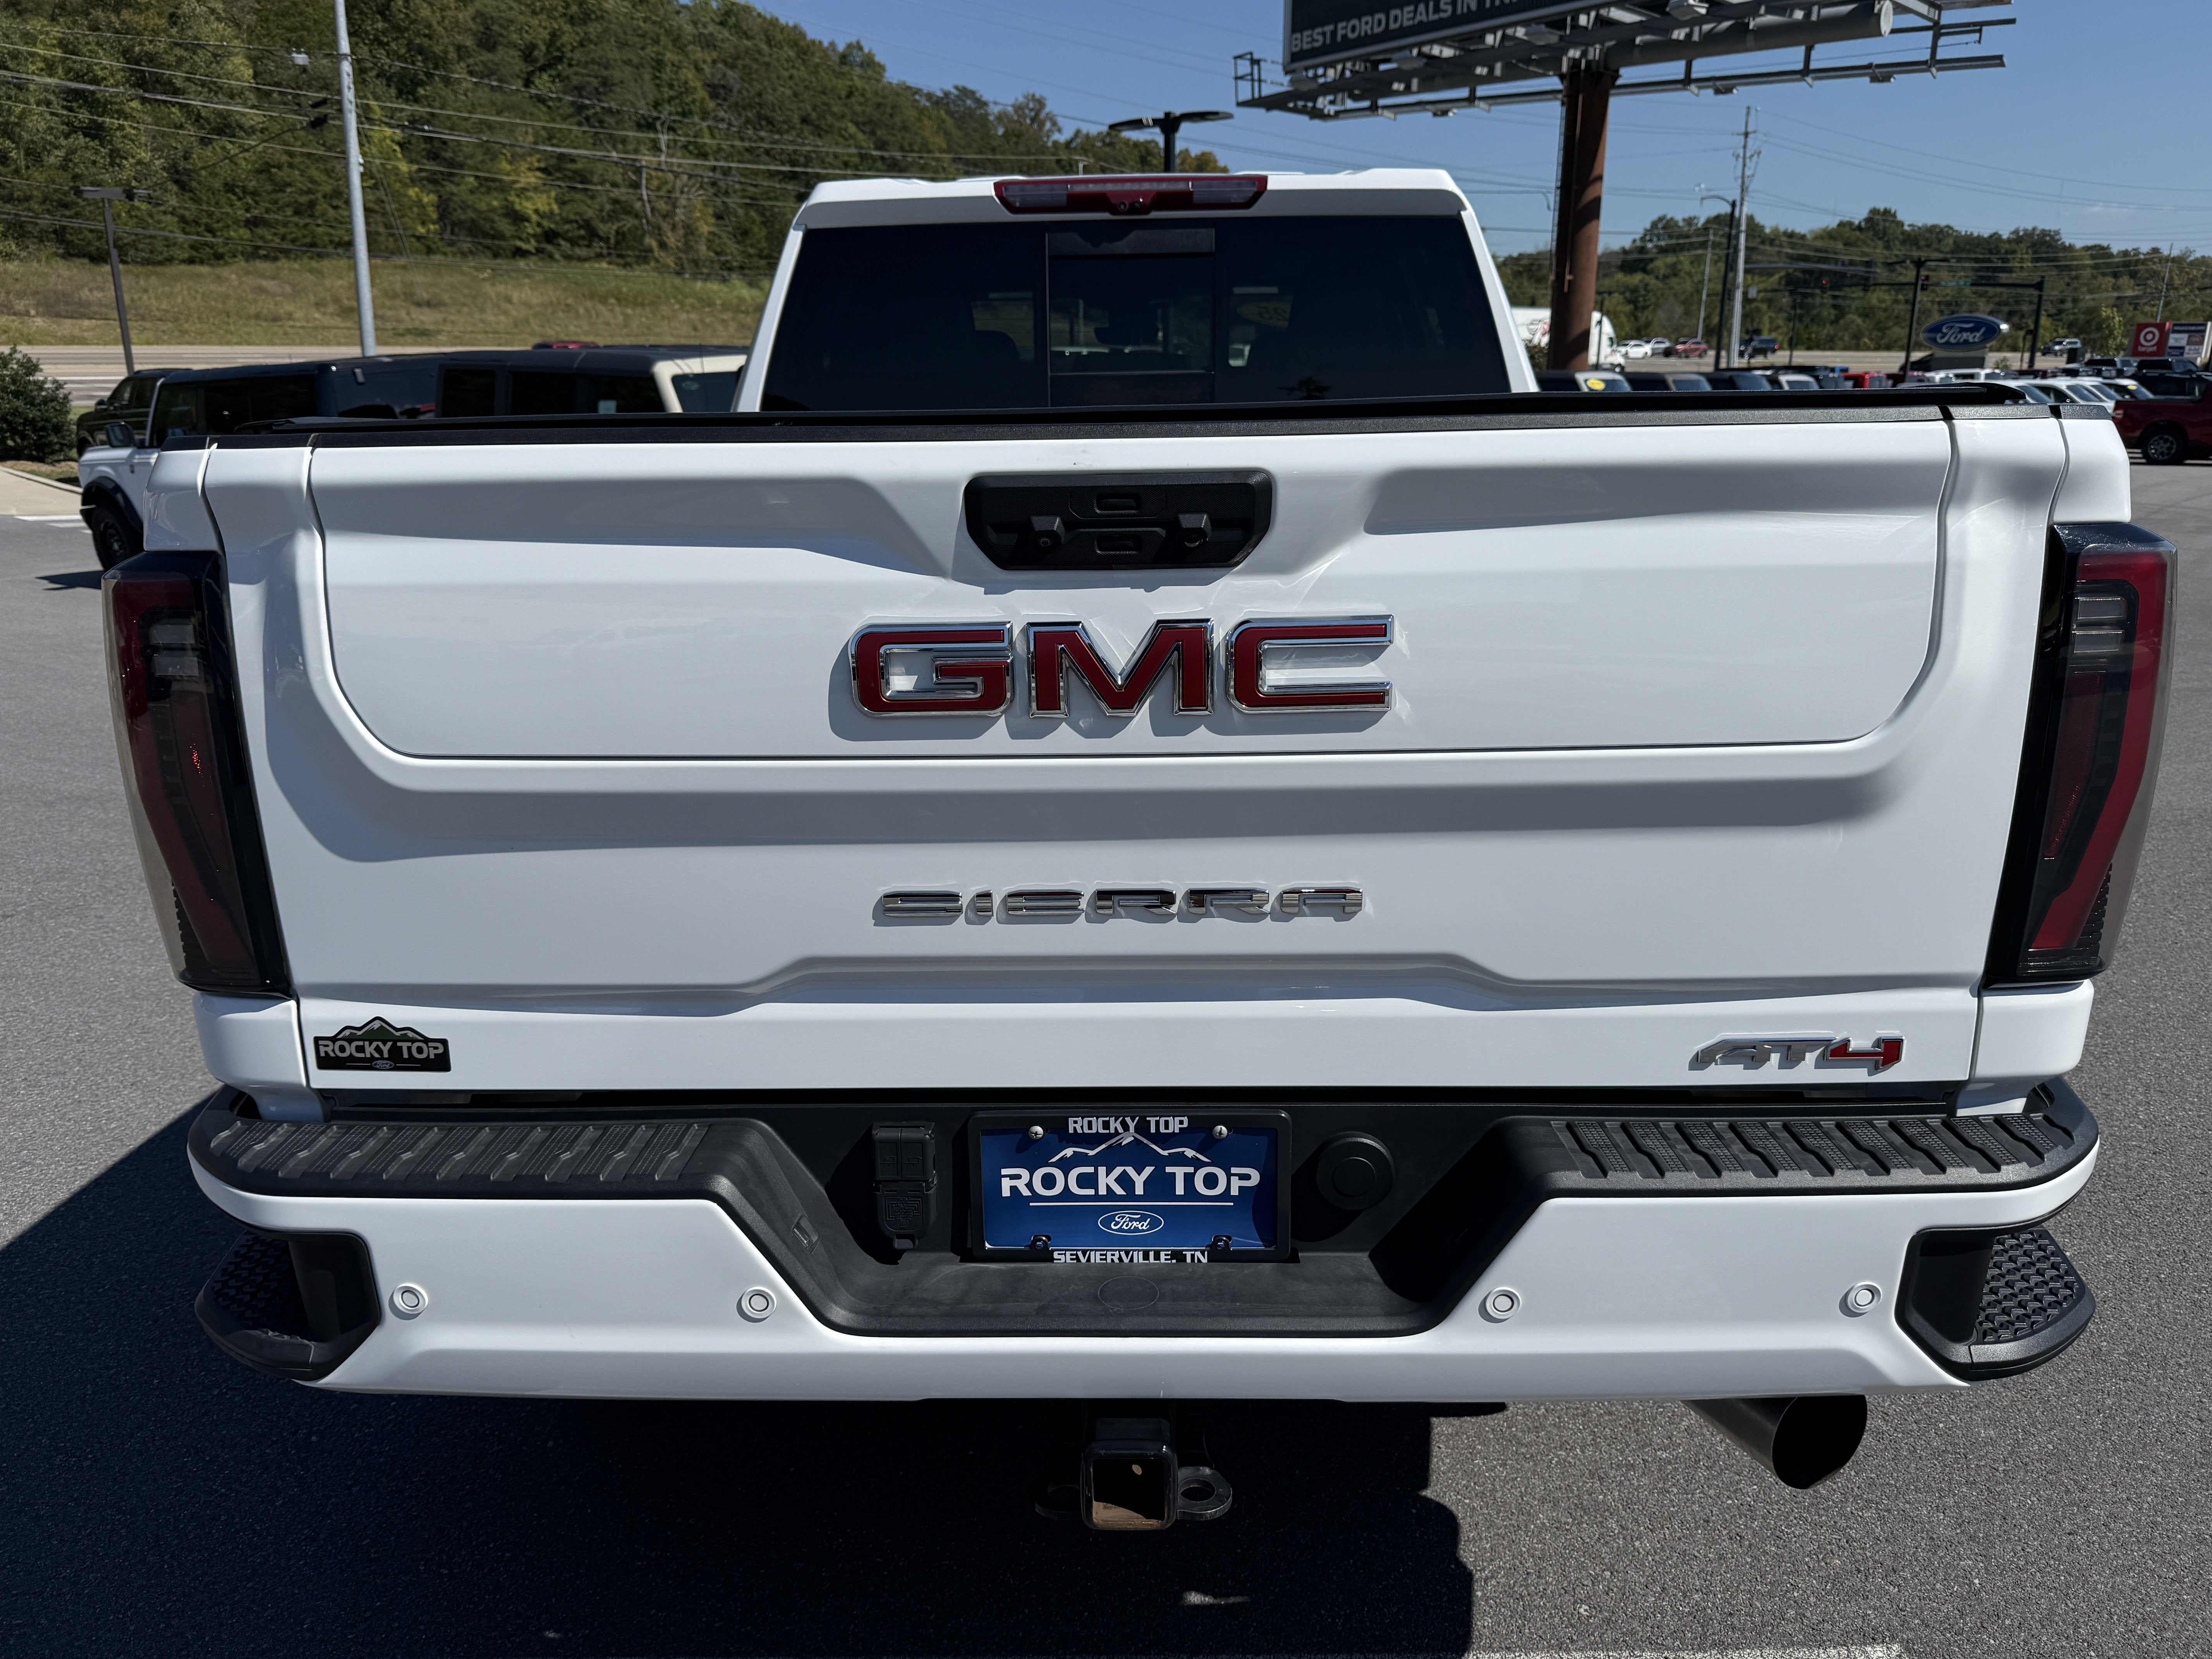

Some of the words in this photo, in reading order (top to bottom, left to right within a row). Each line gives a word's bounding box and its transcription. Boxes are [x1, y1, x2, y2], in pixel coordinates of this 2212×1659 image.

[1292, 24, 1335, 53] BEST
[1336, 12, 1387, 43] FORD
[1388, 0, 1453, 31] DEALS
[1456, 0, 1477, 15] IN
[1937, 322, 1987, 344] Ford
[851, 615, 1394, 718] GMC
[881, 888, 1363, 916] SIERRA
[318, 1040, 393, 1058] ROCKY
[397, 1042, 444, 1059] TOP
[1698, 1036, 1905, 1070] AT4
[1068, 1116, 1139, 1133] ROCKY
[1147, 1116, 1188, 1133] TOP
[1001, 1166, 1156, 1197] ROCKY
[1166, 1166, 1261, 1196] TOP
[1111, 1214, 1150, 1231] Ford
[1183, 1250, 1208, 1263] TN
